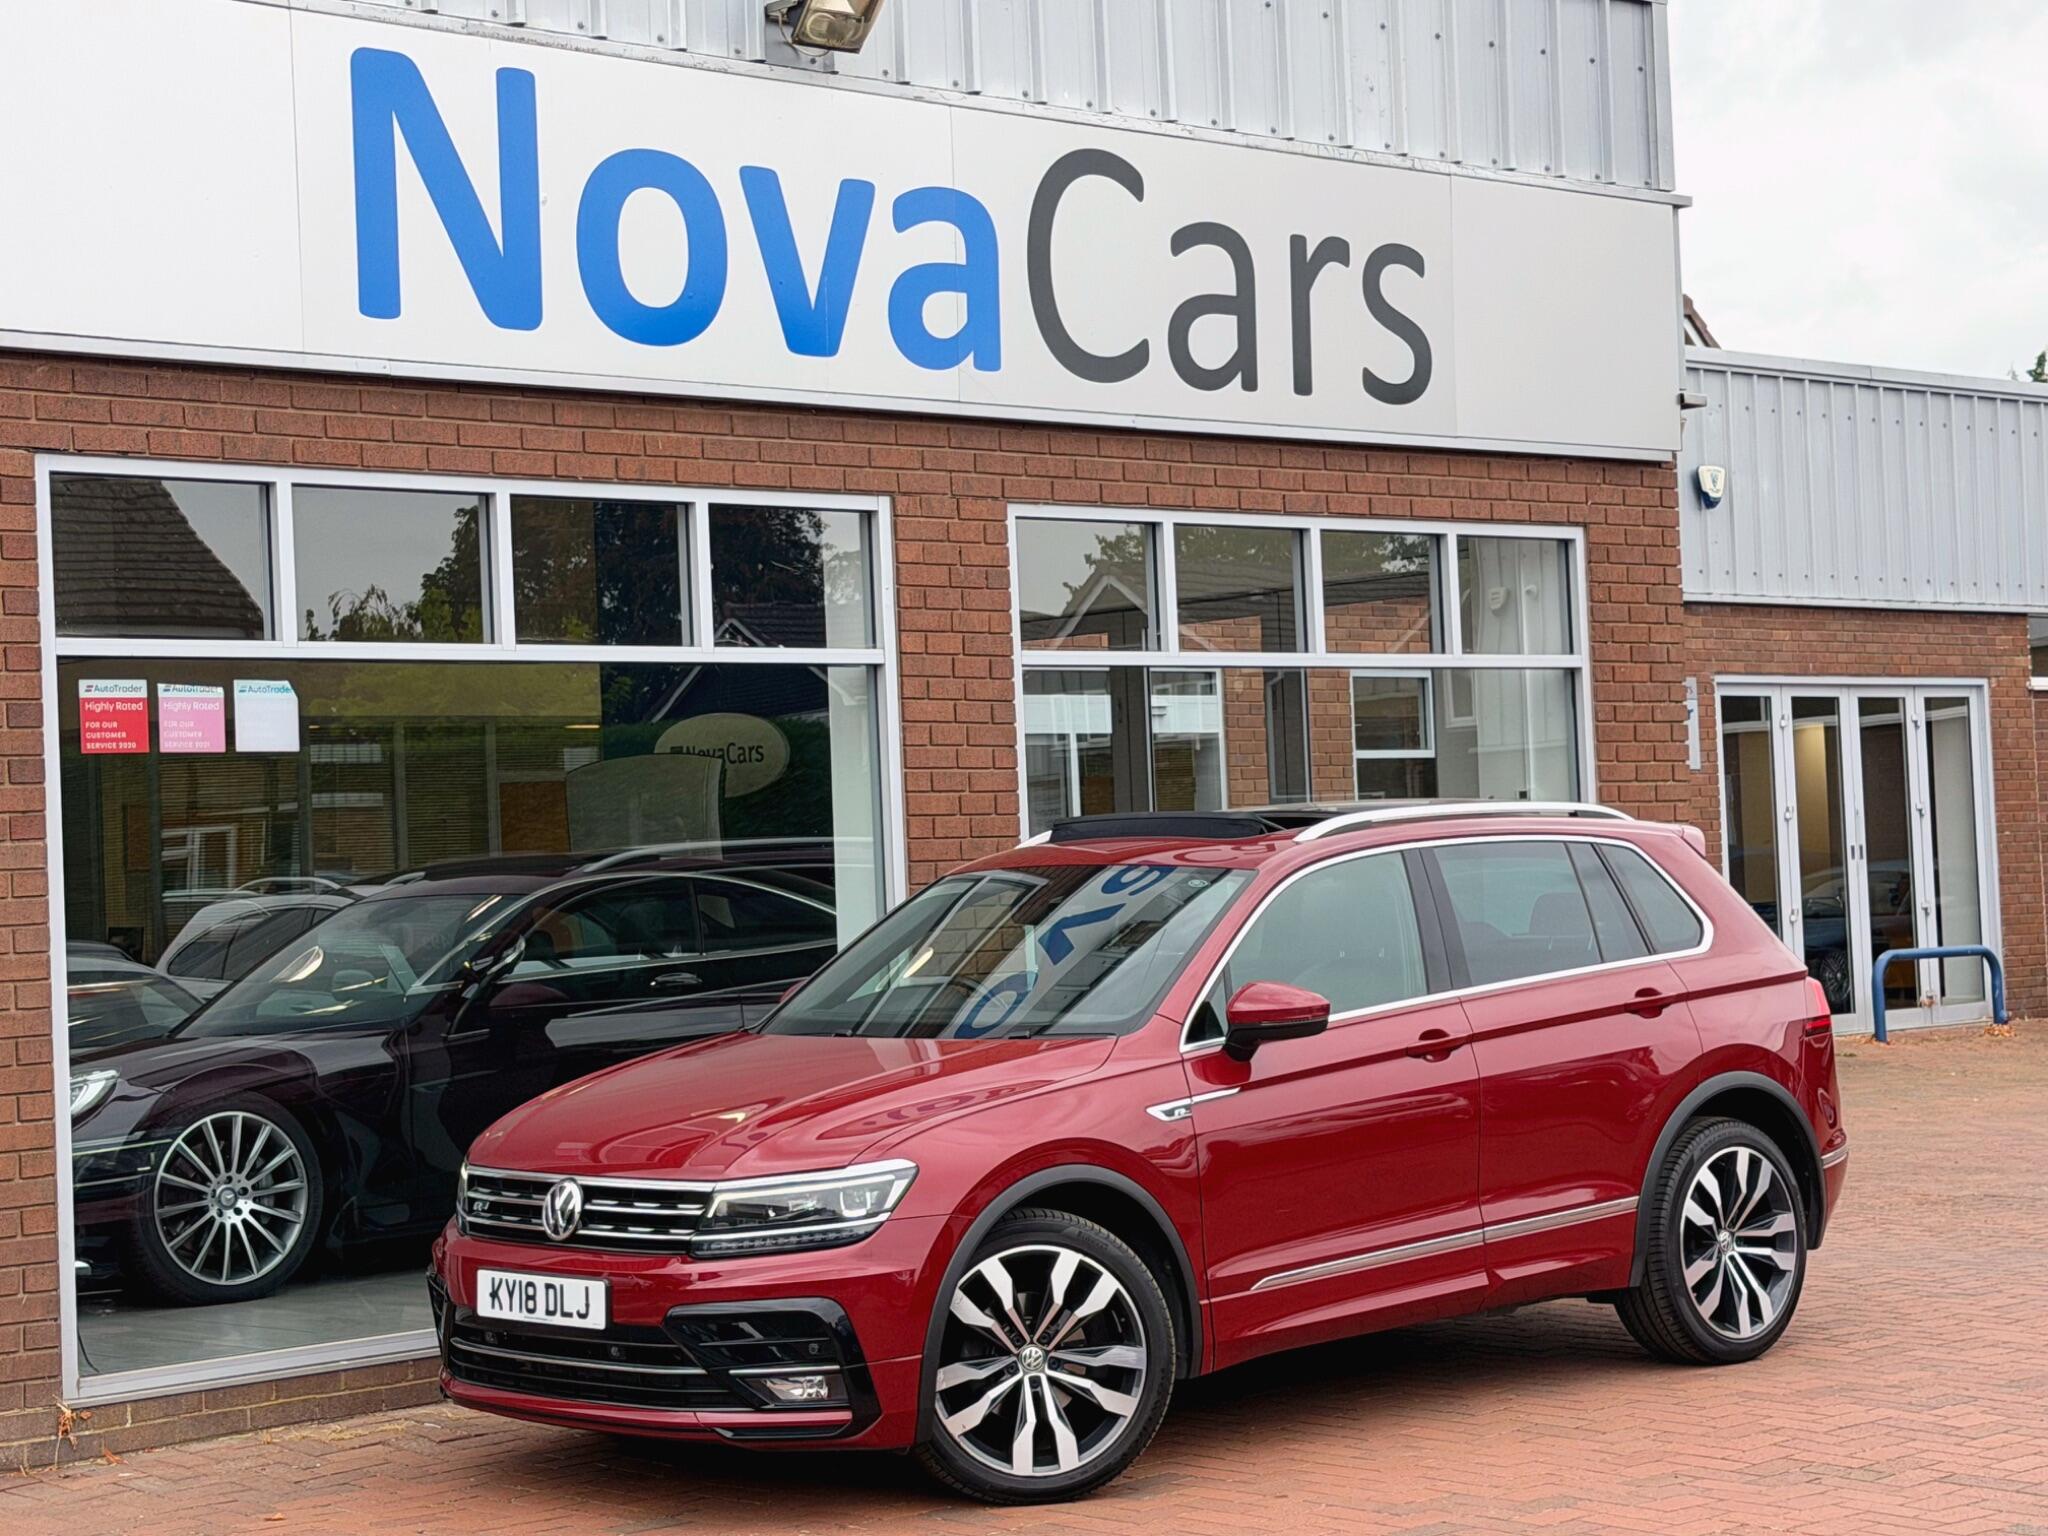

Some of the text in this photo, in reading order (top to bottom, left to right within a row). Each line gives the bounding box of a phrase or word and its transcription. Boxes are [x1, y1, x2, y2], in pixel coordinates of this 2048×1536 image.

[351, 47, 1432, 405] NovaCars
[94, 684, 142, 693] AutoTrader
[247, 685, 292, 694] AutoTrade
[85, 701, 144, 713] Highly Rated
[163, 701, 220, 712] Highly Rated
[85, 721, 118, 729] FOR OUR
[85, 731, 127, 739] CUSTOMER
[489, 1276, 590, 1320] KY18 DLJ
